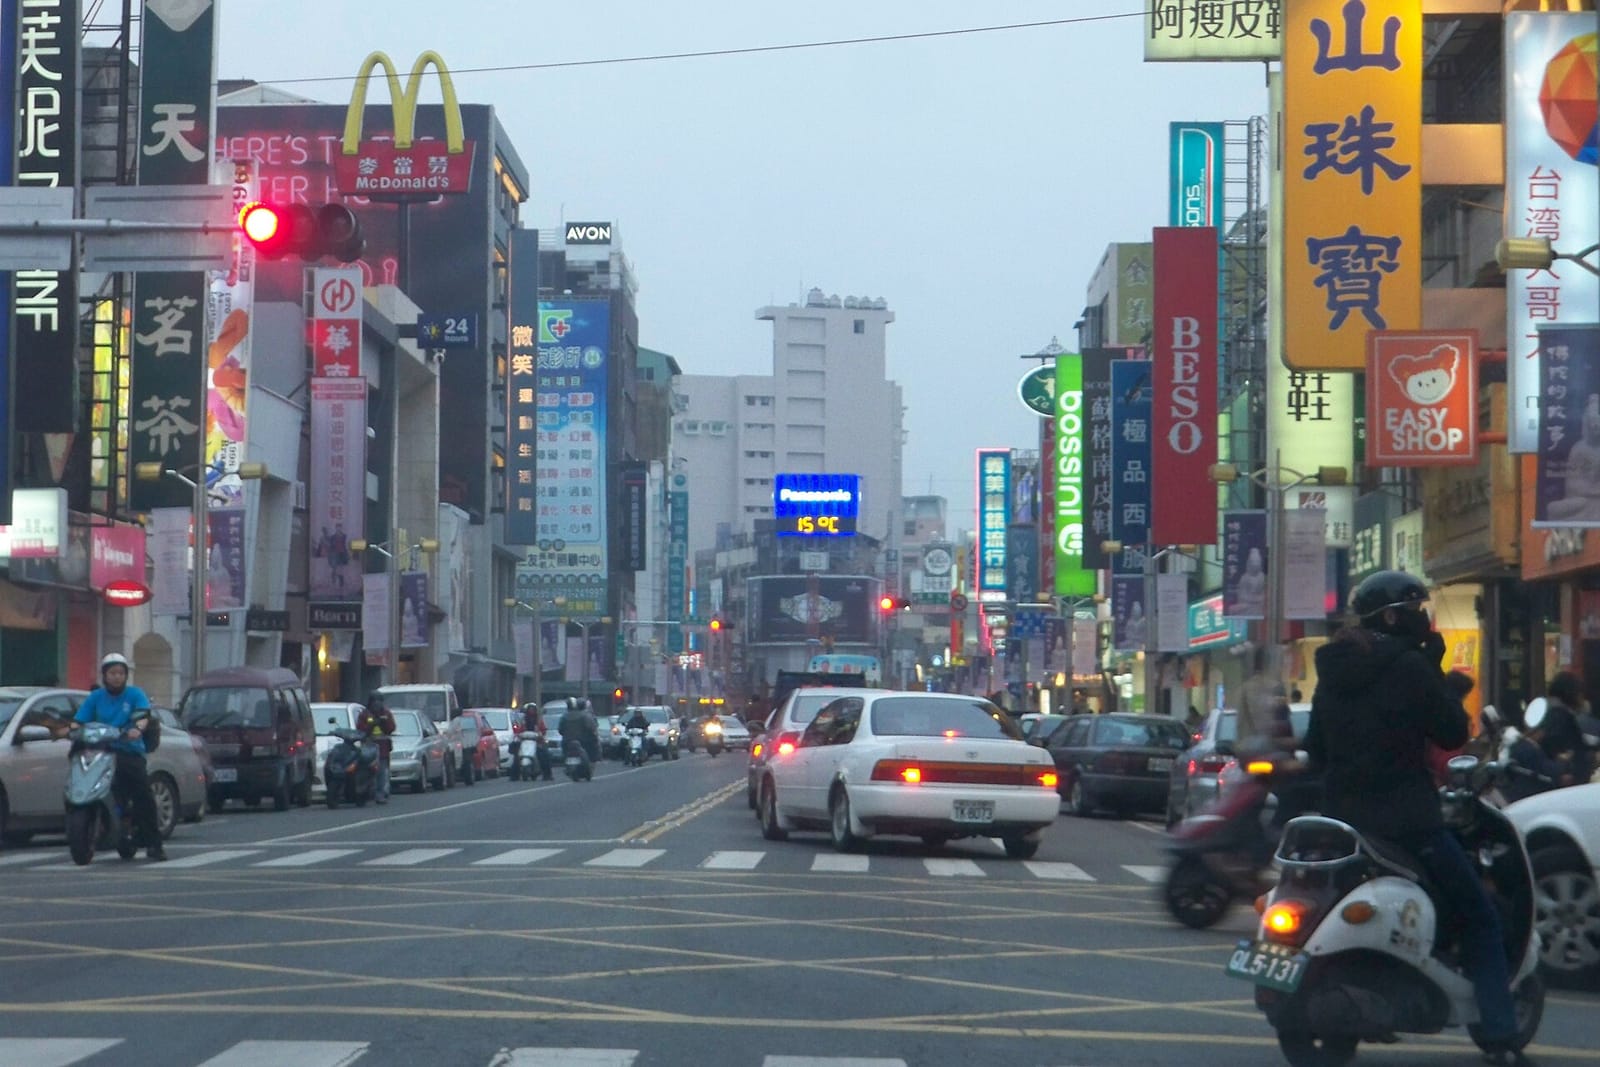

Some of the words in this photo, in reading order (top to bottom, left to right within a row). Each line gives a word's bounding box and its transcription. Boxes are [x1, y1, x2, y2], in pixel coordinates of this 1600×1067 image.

[358, 156, 449, 175] 麥當勞
[356, 175, 449, 189] McDonald's
[1186, 185, 1201, 227] ons
[566, 226, 611, 240] AVON
[444, 318, 469, 334] 24
[1169, 316, 1203, 455] BESO
[1385, 407, 1448, 433] EASY
[1392, 427, 1463, 451] SHOP
[797, 516, 815, 533] 15
